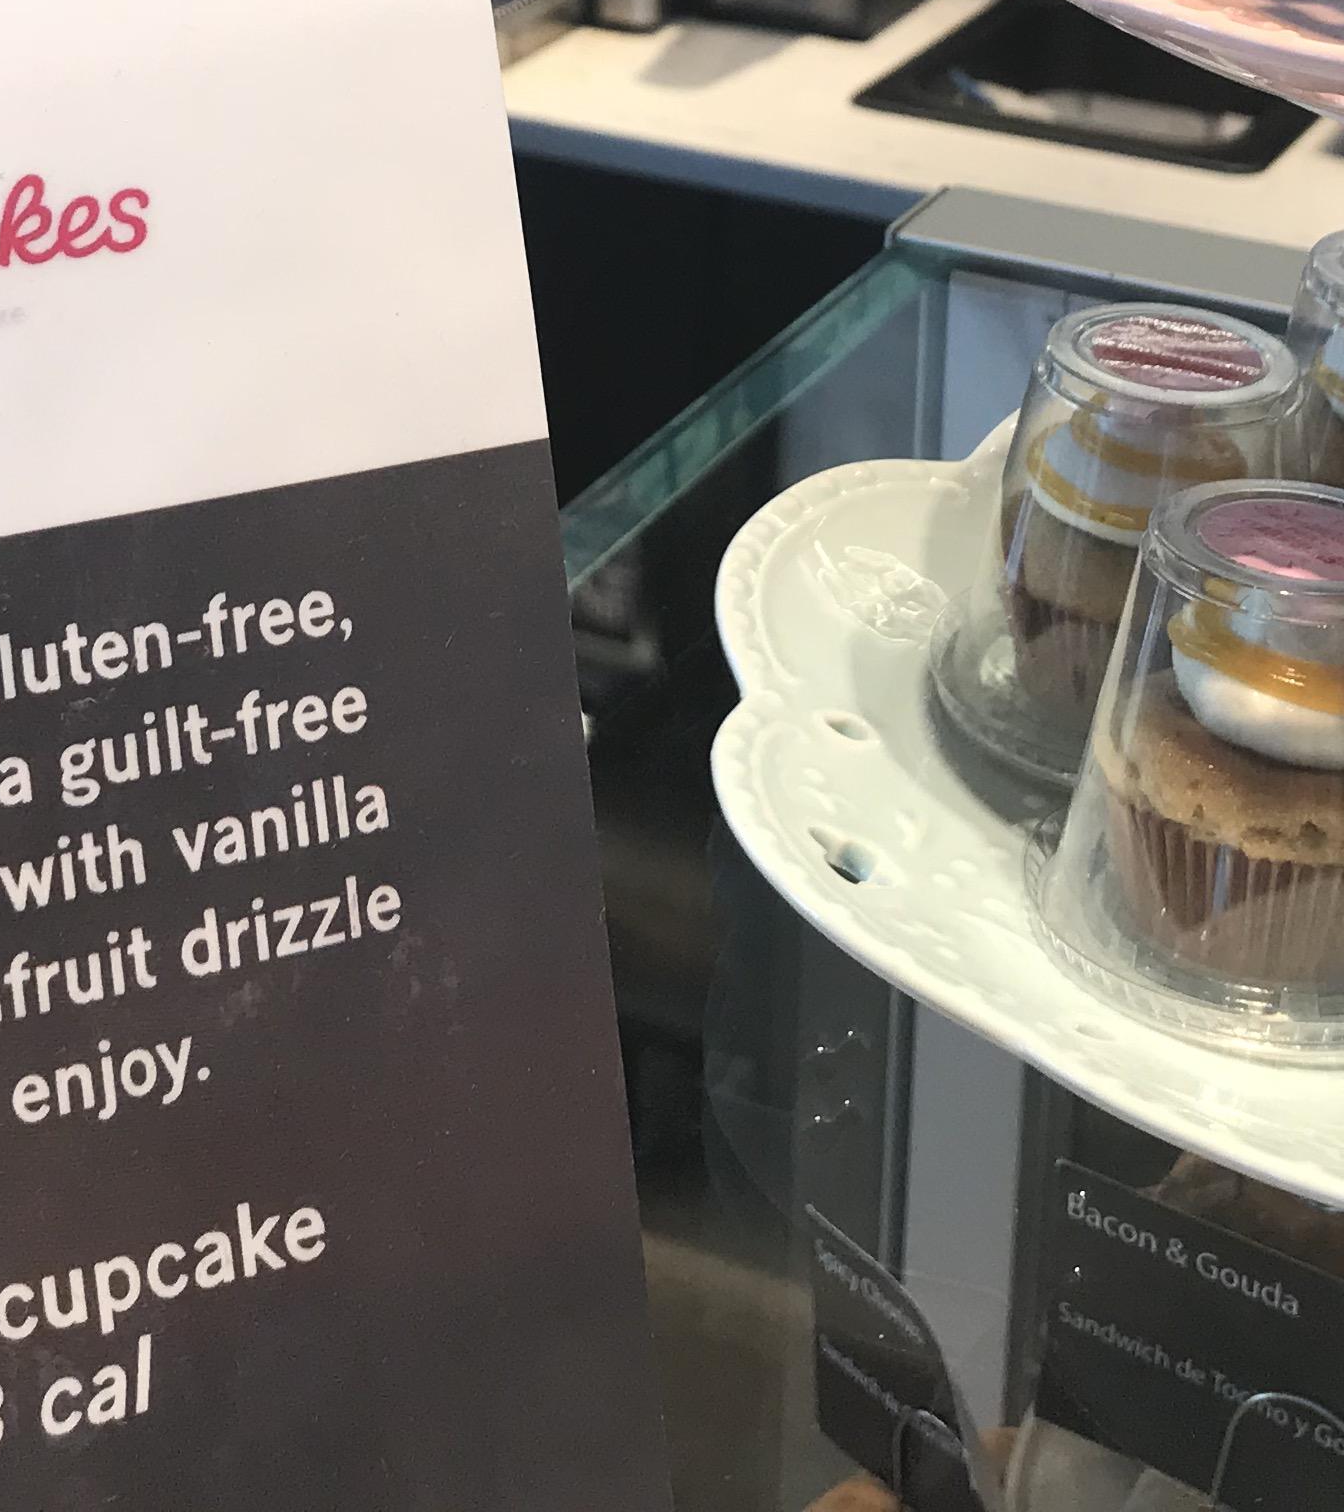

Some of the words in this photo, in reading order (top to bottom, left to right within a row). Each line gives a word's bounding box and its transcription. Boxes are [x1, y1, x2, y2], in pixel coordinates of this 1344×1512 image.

[59, 685, 368, 807] guilt-free
[172, 775, 389, 873] vanilla
[180, 875, 402, 978] drizzle
[11, 1036, 211, 1120] enjoy.
[1066, 1191, 1158, 1254] Bacon
[1164, 1238, 1189, 1268] &
[1195, 1251, 1302, 1318] Gouda
[40, 1333, 152, 1436] cal
[1058, 1301, 1171, 1370] Sandwich
[1175, 1358, 1207, 1387] de
[1293, 1416, 1310, 1440] y
